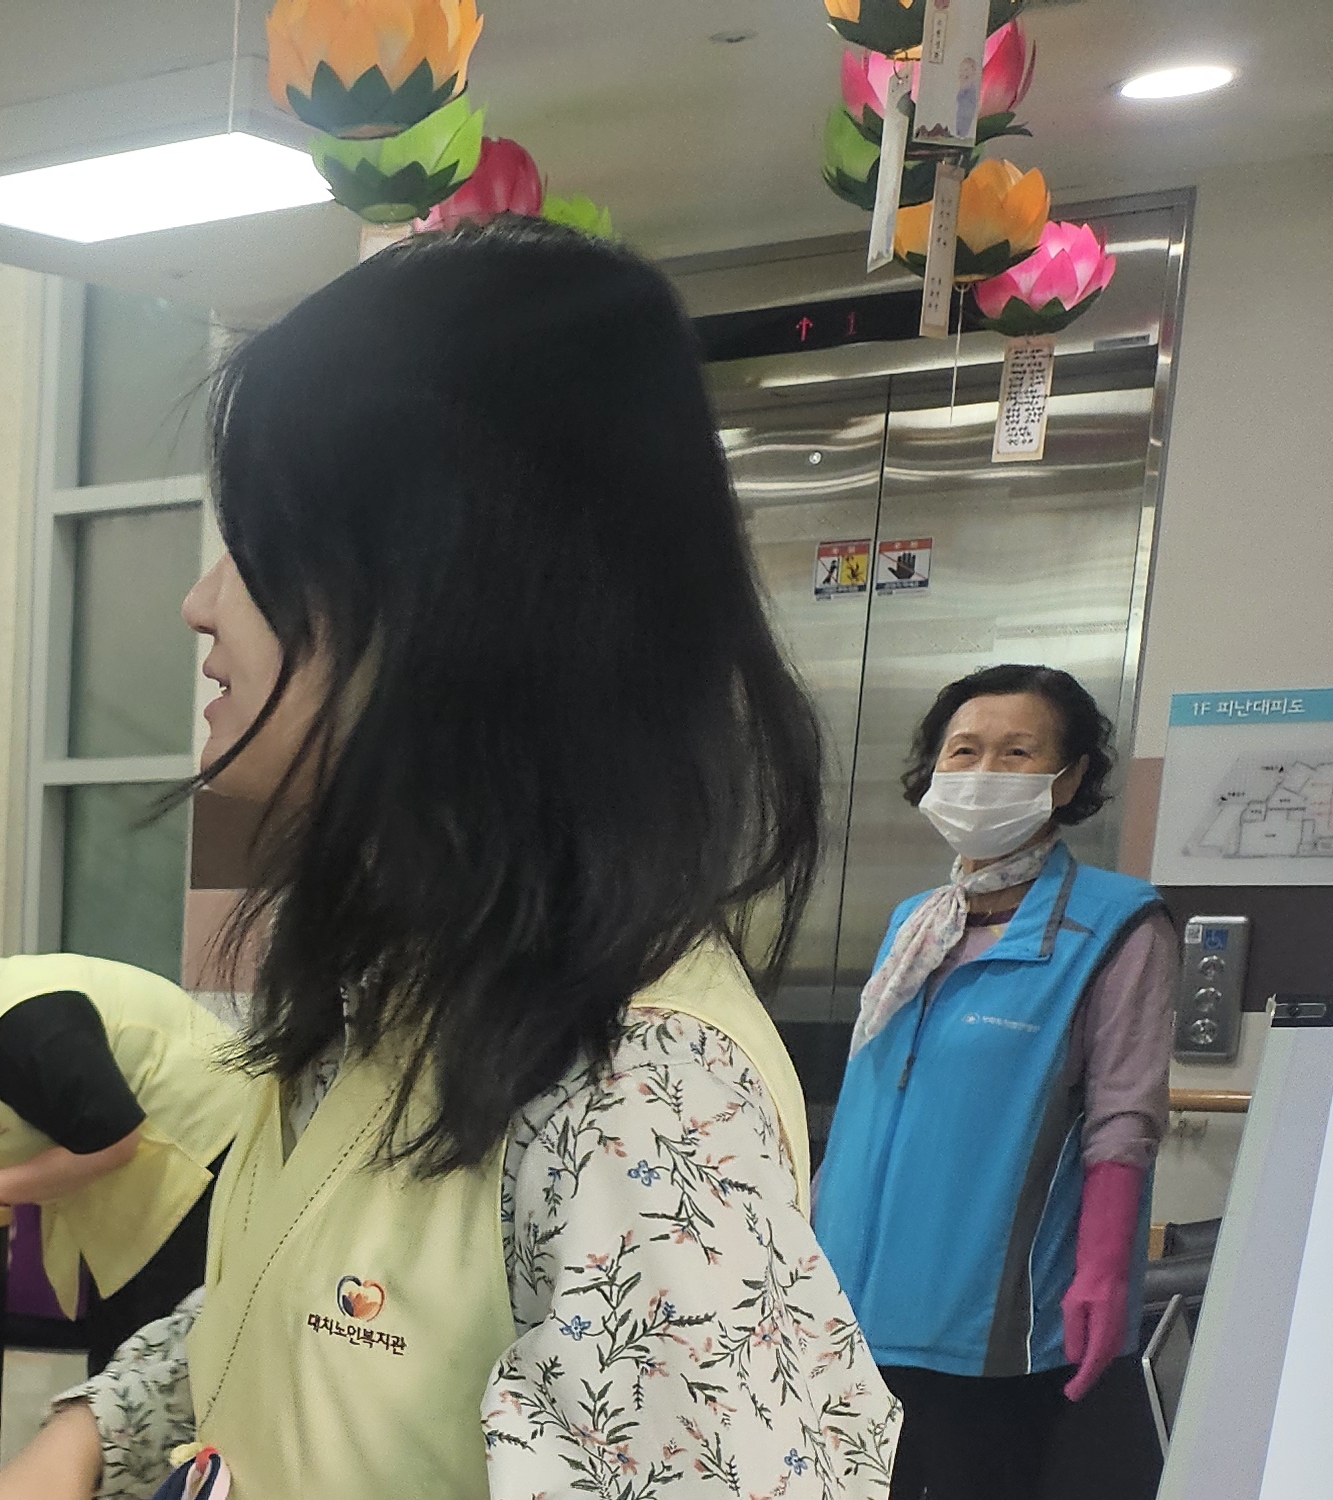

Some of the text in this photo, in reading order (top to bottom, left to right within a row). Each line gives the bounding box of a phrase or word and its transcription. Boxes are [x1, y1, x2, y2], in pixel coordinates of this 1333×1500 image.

[1193, 697, 1306, 718] 1F 피난대피도
[307, 1313, 407, 1355] 대치노인복지관
